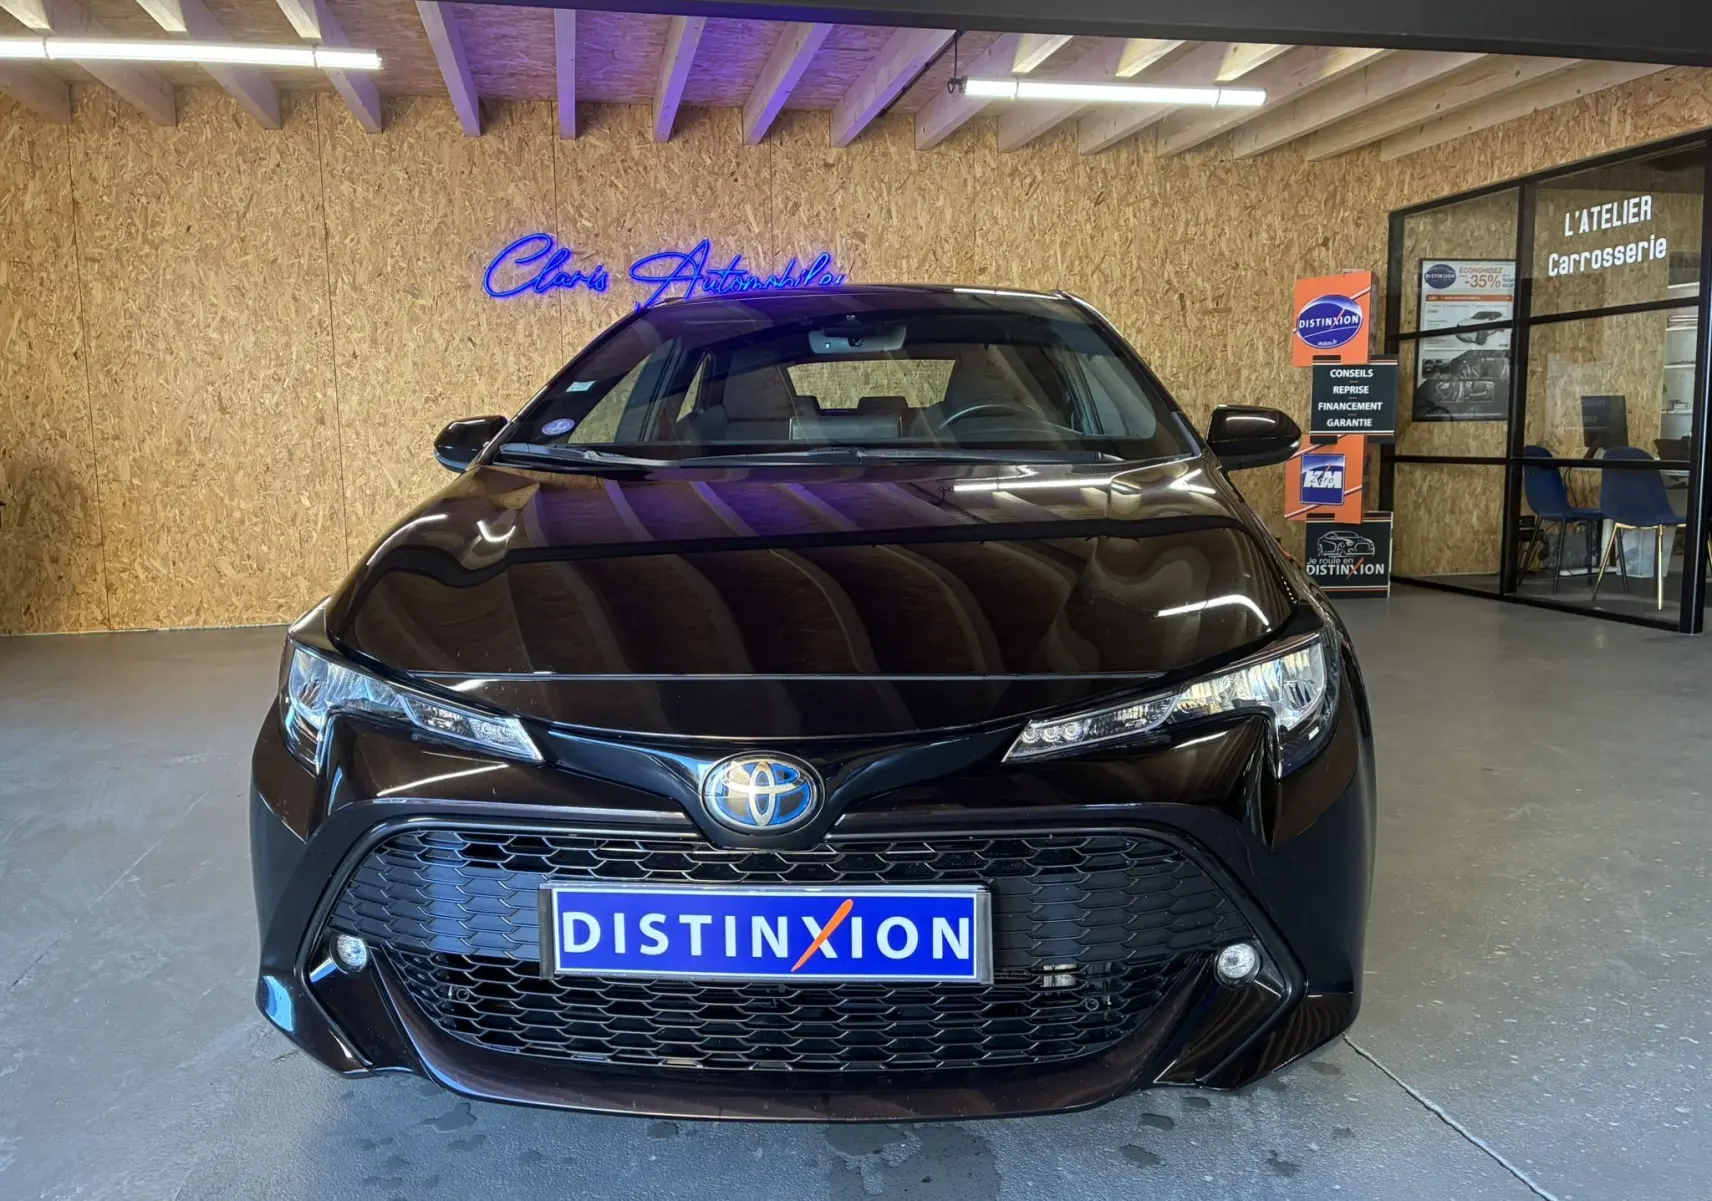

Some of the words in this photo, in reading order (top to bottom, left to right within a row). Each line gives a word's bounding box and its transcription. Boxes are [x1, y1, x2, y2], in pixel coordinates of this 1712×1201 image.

[1564, 194, 1652, 237] L'ATELIER
[1548, 234, 1667, 277] Carrosserie
[484, 233, 608, 297] Claris
[1464, 274, 1501, 288] -35%
[1298, 311, 1359, 330] DISTINXION
[1329, 368, 1374, 378] CONSEILS
[1332, 385, 1370, 394] REPRISE
[1317, 402, 1383, 411] FINANCEMENT
[1326, 418, 1373, 427] GARANTIE
[1307, 557, 1317, 565] Je
[1319, 556, 1341, 565] roule
[1306, 560, 1385, 577] DISTINXION
[562, 903, 970, 969] DISTINXION
